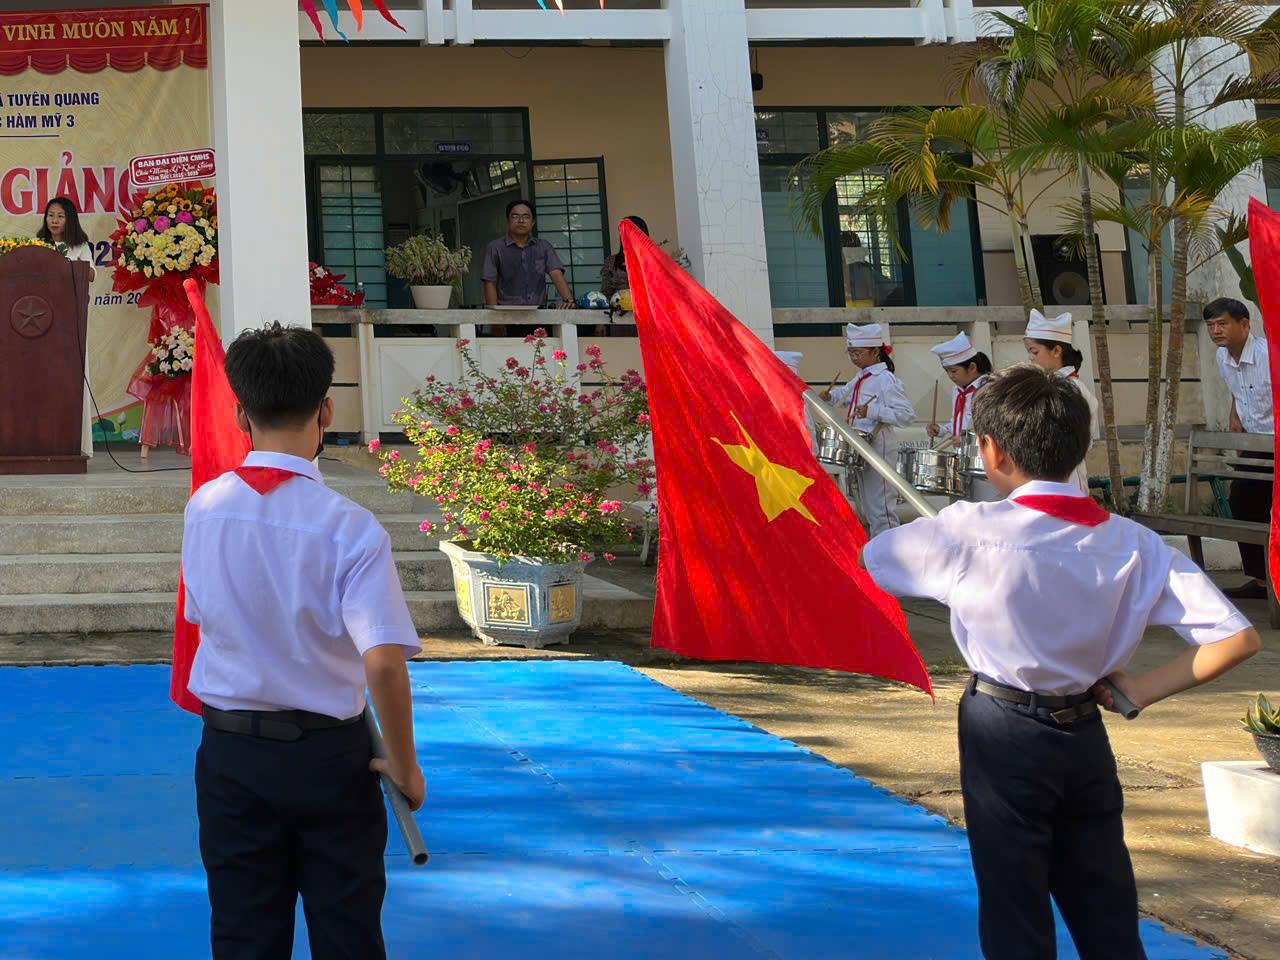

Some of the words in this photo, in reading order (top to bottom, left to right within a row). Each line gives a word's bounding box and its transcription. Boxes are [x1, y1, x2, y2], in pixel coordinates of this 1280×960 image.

[2, 23, 56, 41] VINH
[62, 17, 125, 39] MUÔN
[131, 16, 178, 36] NĂM
[7, 91, 50, 107] TUYÊN
[54, 92, 100, 106] QUANG
[6, 113, 37, 128] HÀM
[41, 113, 62, 128] MỸ
[66, 114, 75, 128] 3
[95, 291, 122, 305] năm
